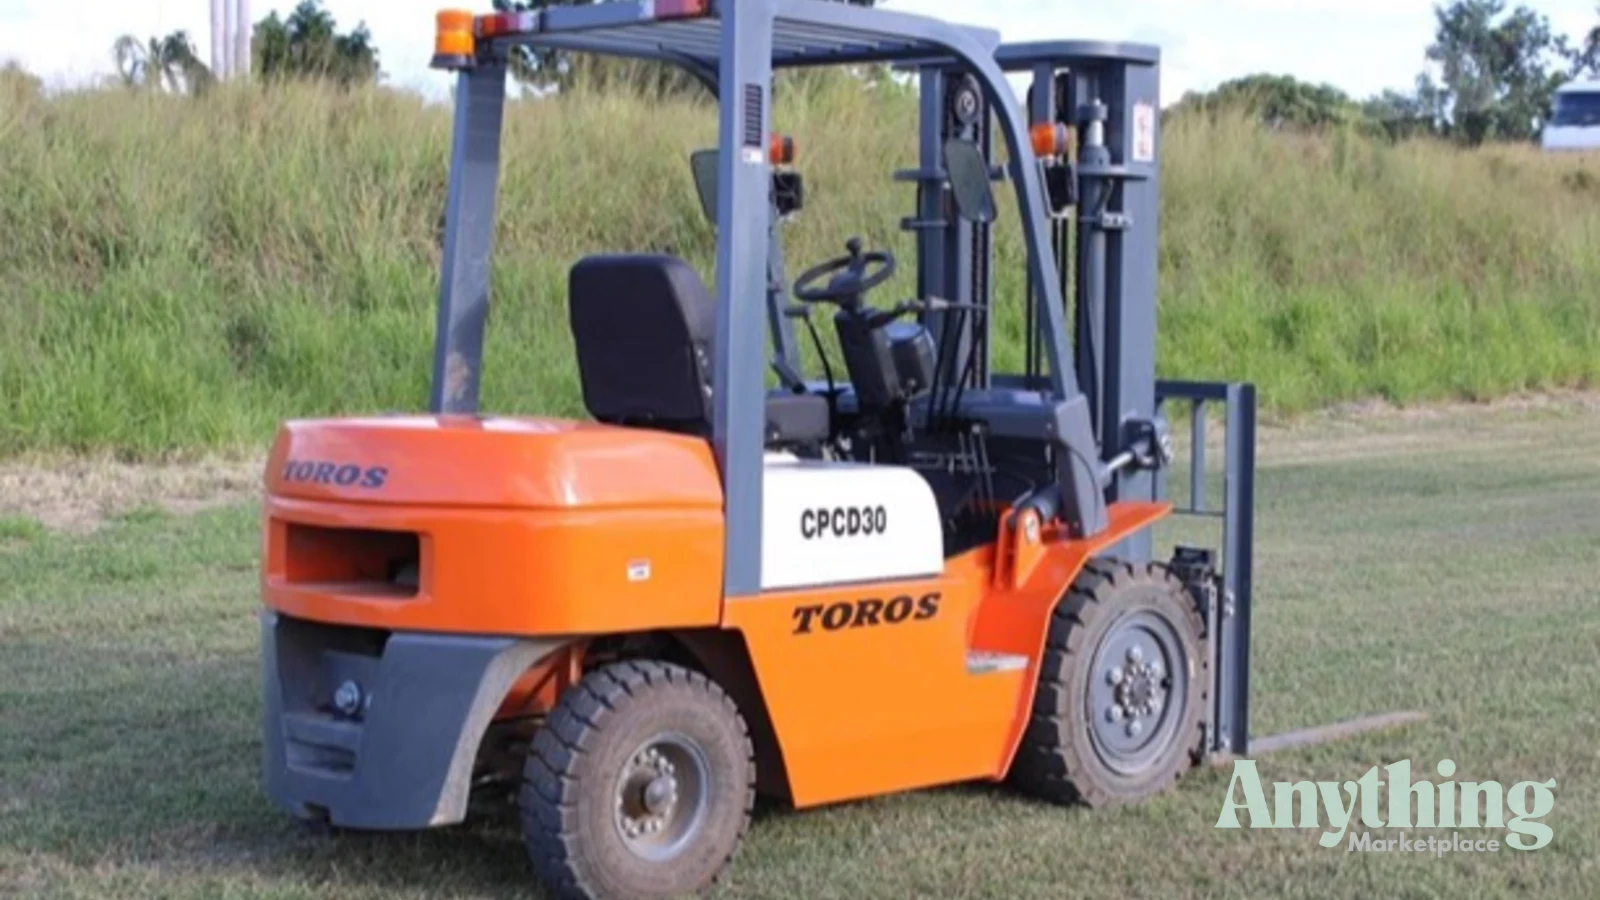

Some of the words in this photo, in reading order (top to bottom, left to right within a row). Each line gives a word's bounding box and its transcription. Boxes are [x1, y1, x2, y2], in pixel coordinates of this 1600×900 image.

[282, 461, 389, 488] TOROS
[800, 504, 887, 539] CPCD30
[792, 592, 941, 635] TOROS
